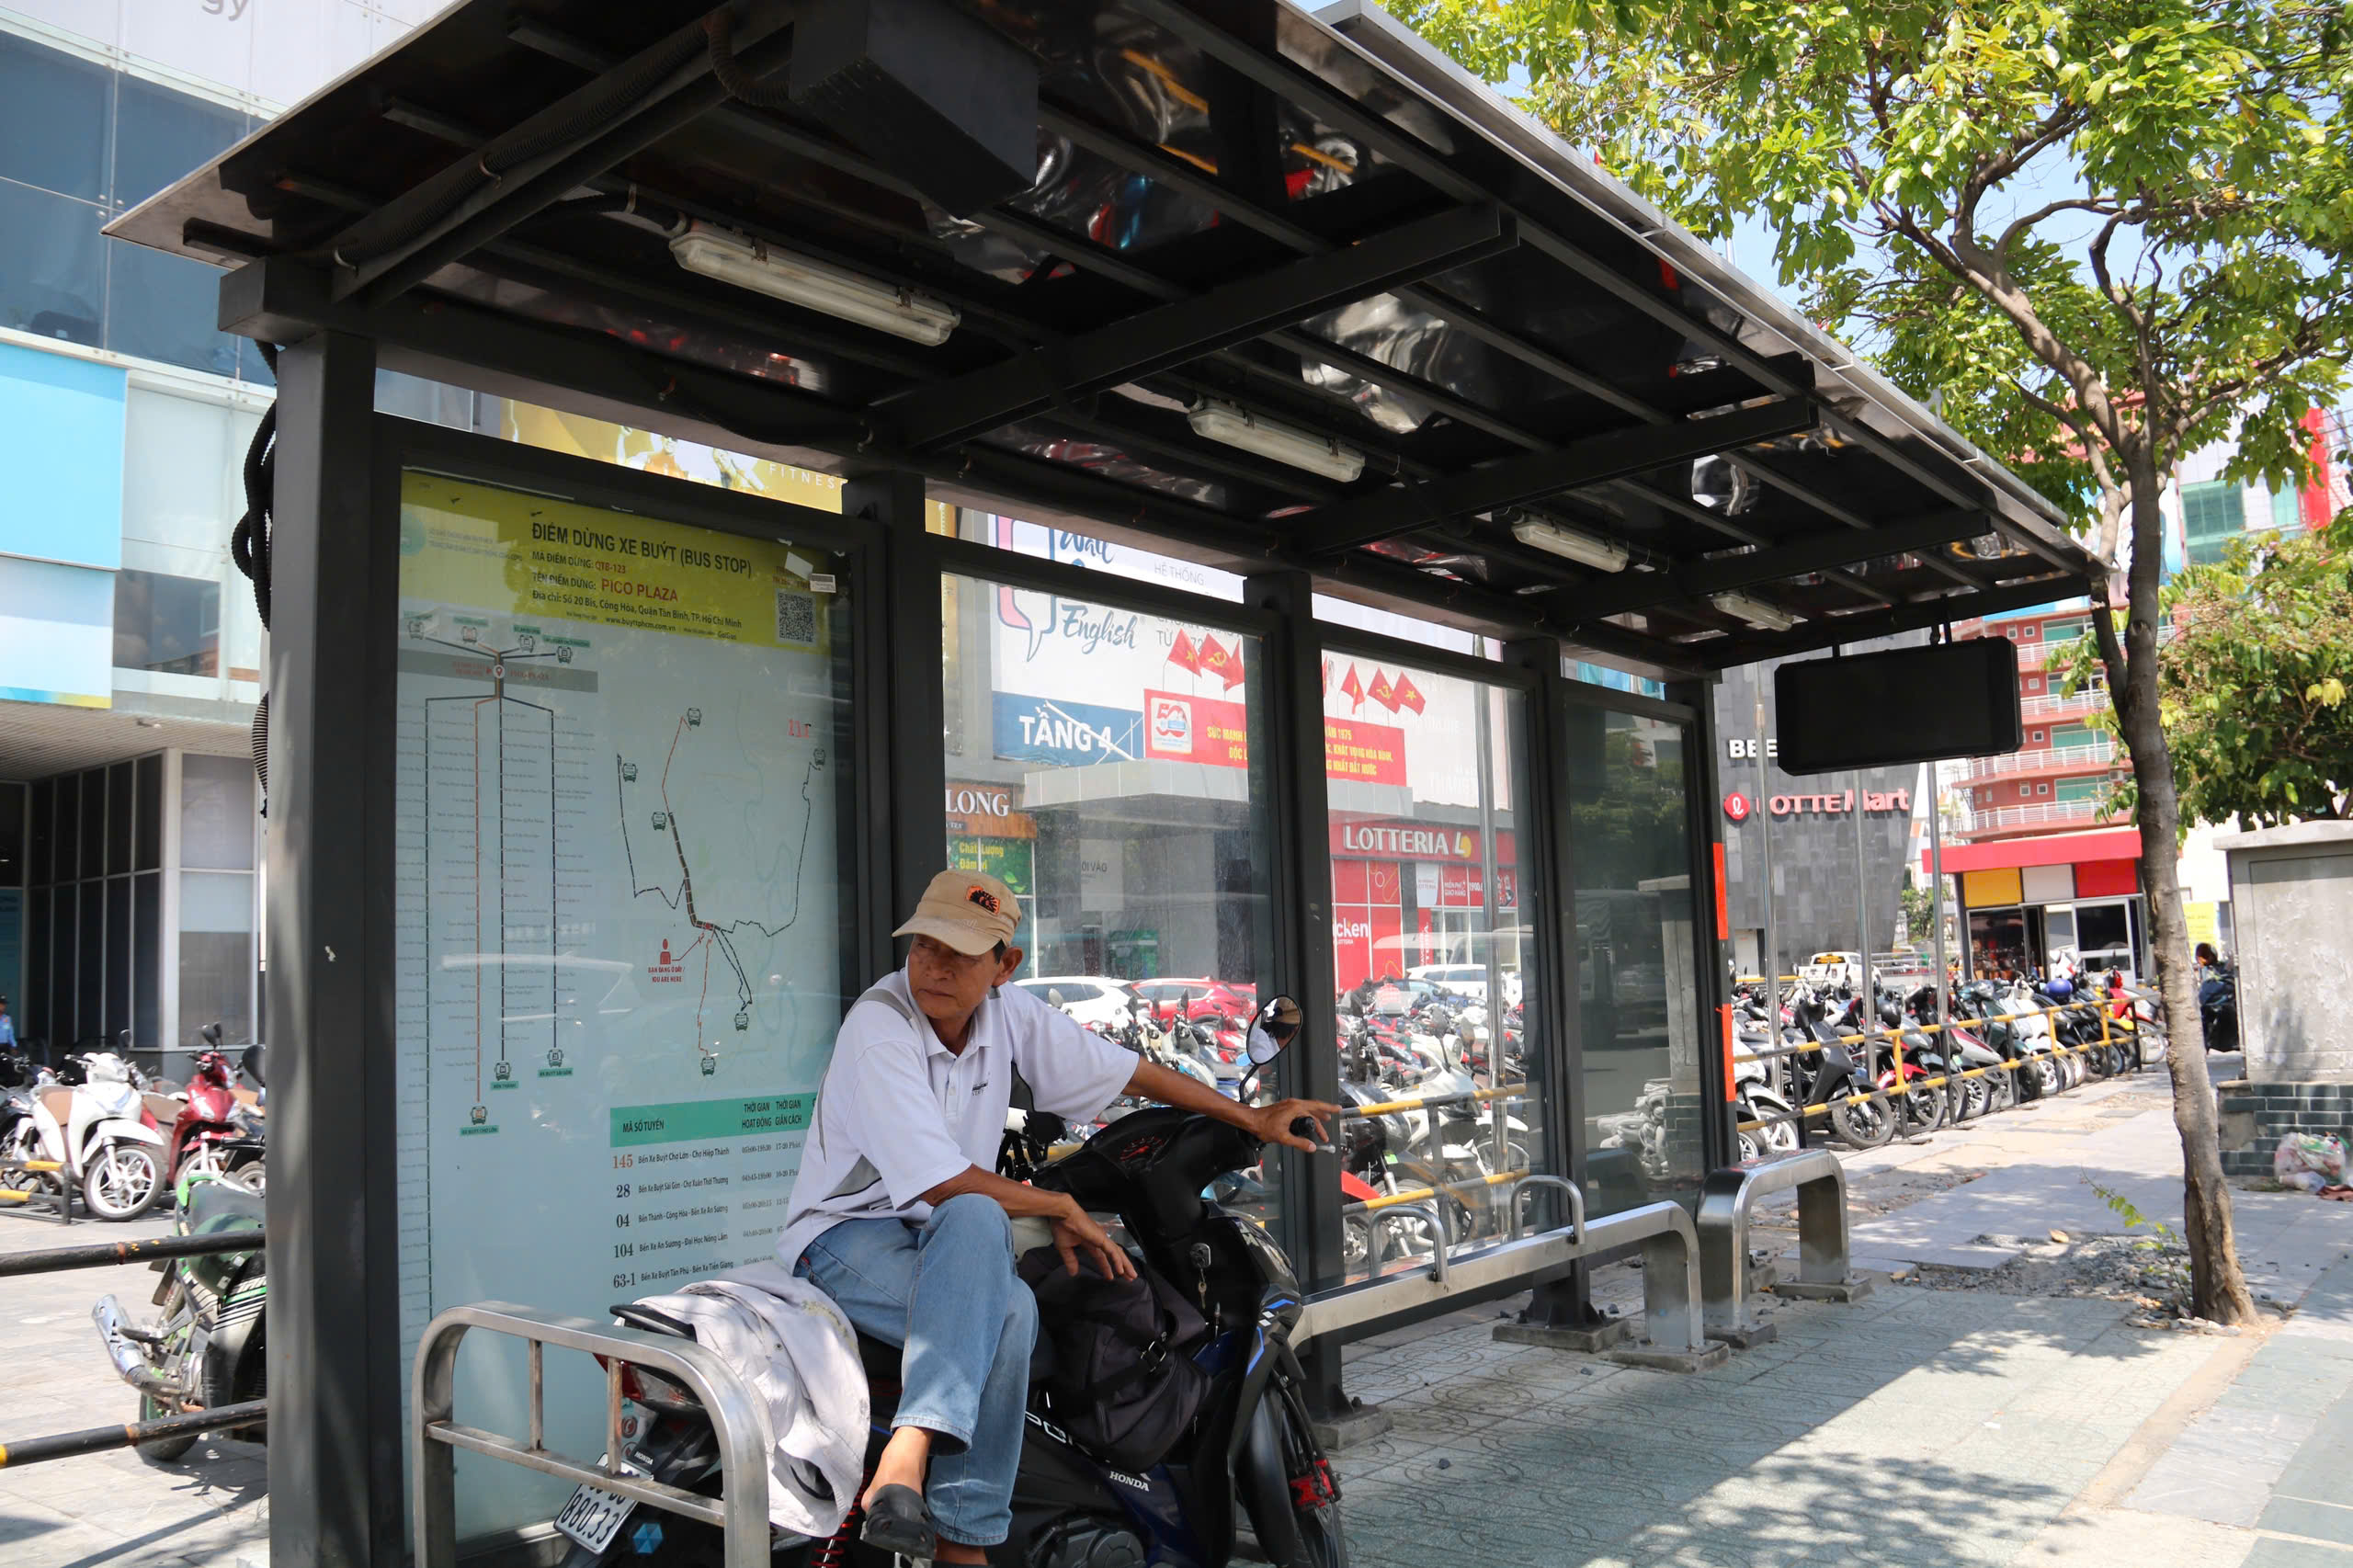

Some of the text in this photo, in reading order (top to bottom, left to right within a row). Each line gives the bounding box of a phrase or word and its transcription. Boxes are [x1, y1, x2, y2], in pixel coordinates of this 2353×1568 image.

[769, 462, 836, 490] FITNES
[573, 527, 615, 551] DỪNG
[619, 537, 637, 555] XE
[641, 540, 676, 562] BUÝT
[680, 548, 710, 569] (BUS
[714, 554, 752, 579] STOP)
[602, 578, 633, 596] PICO
[637, 584, 678, 603] PLAZA
[574, 596, 584, 606] 20
[725, 617, 742, 630] Minh
[1061, 603, 1137, 654] English
[1019, 705, 1092, 752] TẦNG
[945, 789, 1009, 817] LONG
[1343, 824, 1449, 856] LOTTERIA
[613, 1154, 633, 1169] 145
[617, 1183, 631, 1198] 28
[617, 1213, 630, 1228] 04
[614, 1243, 633, 1258] 104
[613, 1272, 636, 1288] 63-1
[634, 1451, 654, 1465] HONDA
[1109, 1471, 1150, 1492] HONDA
[561, 1493, 620, 1544] 880.33
